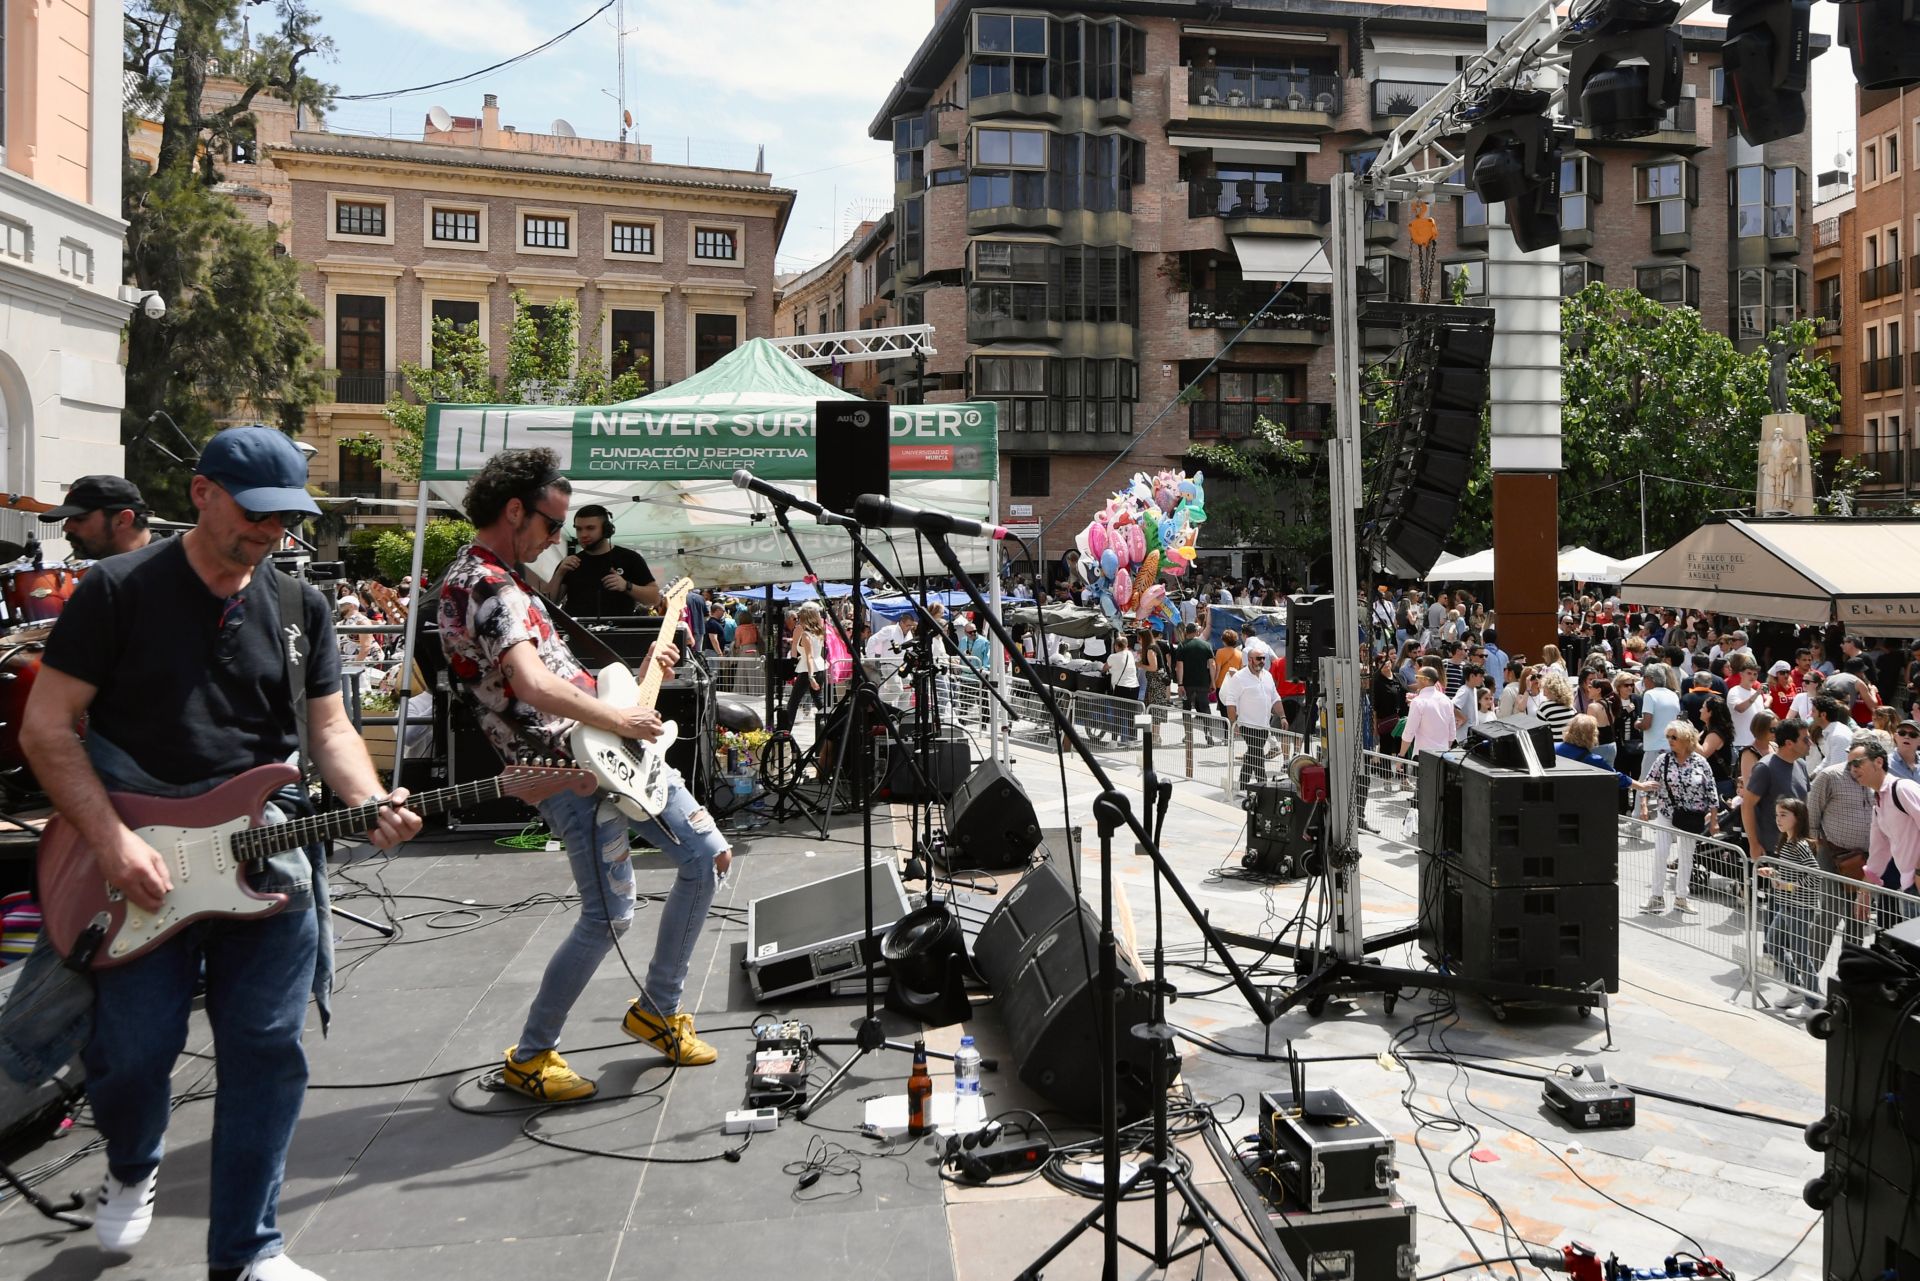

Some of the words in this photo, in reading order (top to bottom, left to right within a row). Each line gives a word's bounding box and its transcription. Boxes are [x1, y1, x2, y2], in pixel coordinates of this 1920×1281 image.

[590, 411, 721, 437] NEVER
[590, 445, 699, 459] FUNDACIÓN
[703, 447, 809, 459] DEPORTIVA
[589, 459, 661, 471] CONTRA
[663, 460, 685, 470] EL
[686, 457, 756, 471] CÁNCER
[1687, 553, 1697, 561] EL
[1701, 554, 1726, 562] PALCO
[1851, 604, 1874, 615] EL
[283, 623, 303, 666] Fender
